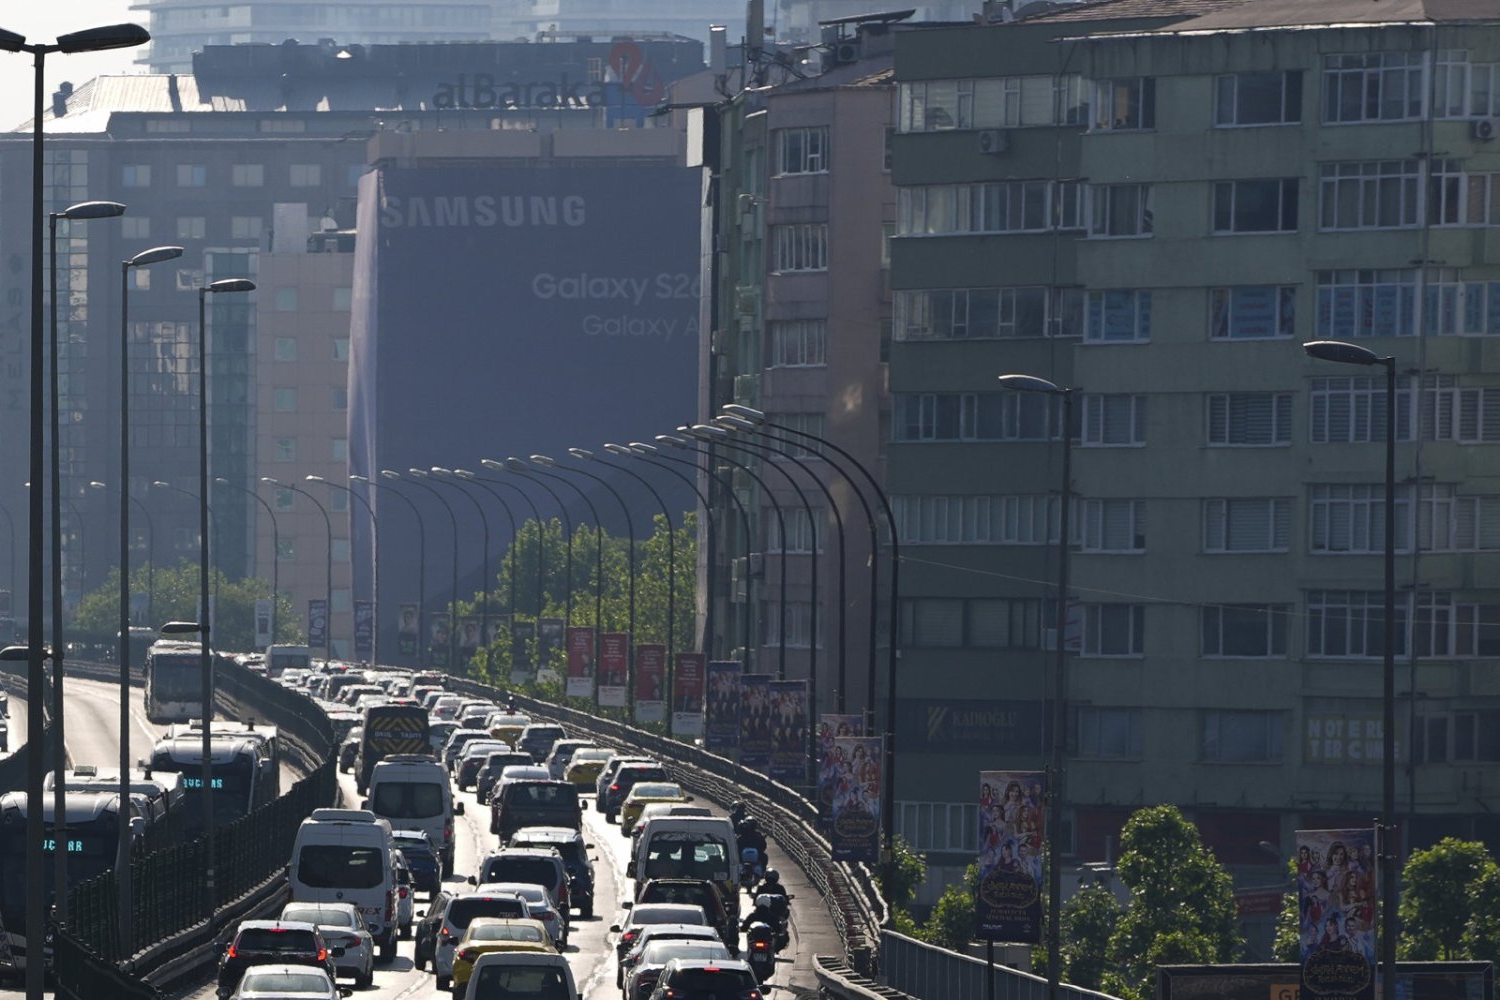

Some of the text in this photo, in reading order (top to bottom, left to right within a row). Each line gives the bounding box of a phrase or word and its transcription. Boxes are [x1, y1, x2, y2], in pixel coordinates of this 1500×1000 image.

[433, 71, 607, 109] alBaraka
[381, 195, 586, 229] SAMSUNG
[532, 272, 648, 305] Galaxy
[582, 314, 677, 342] Galaxy
